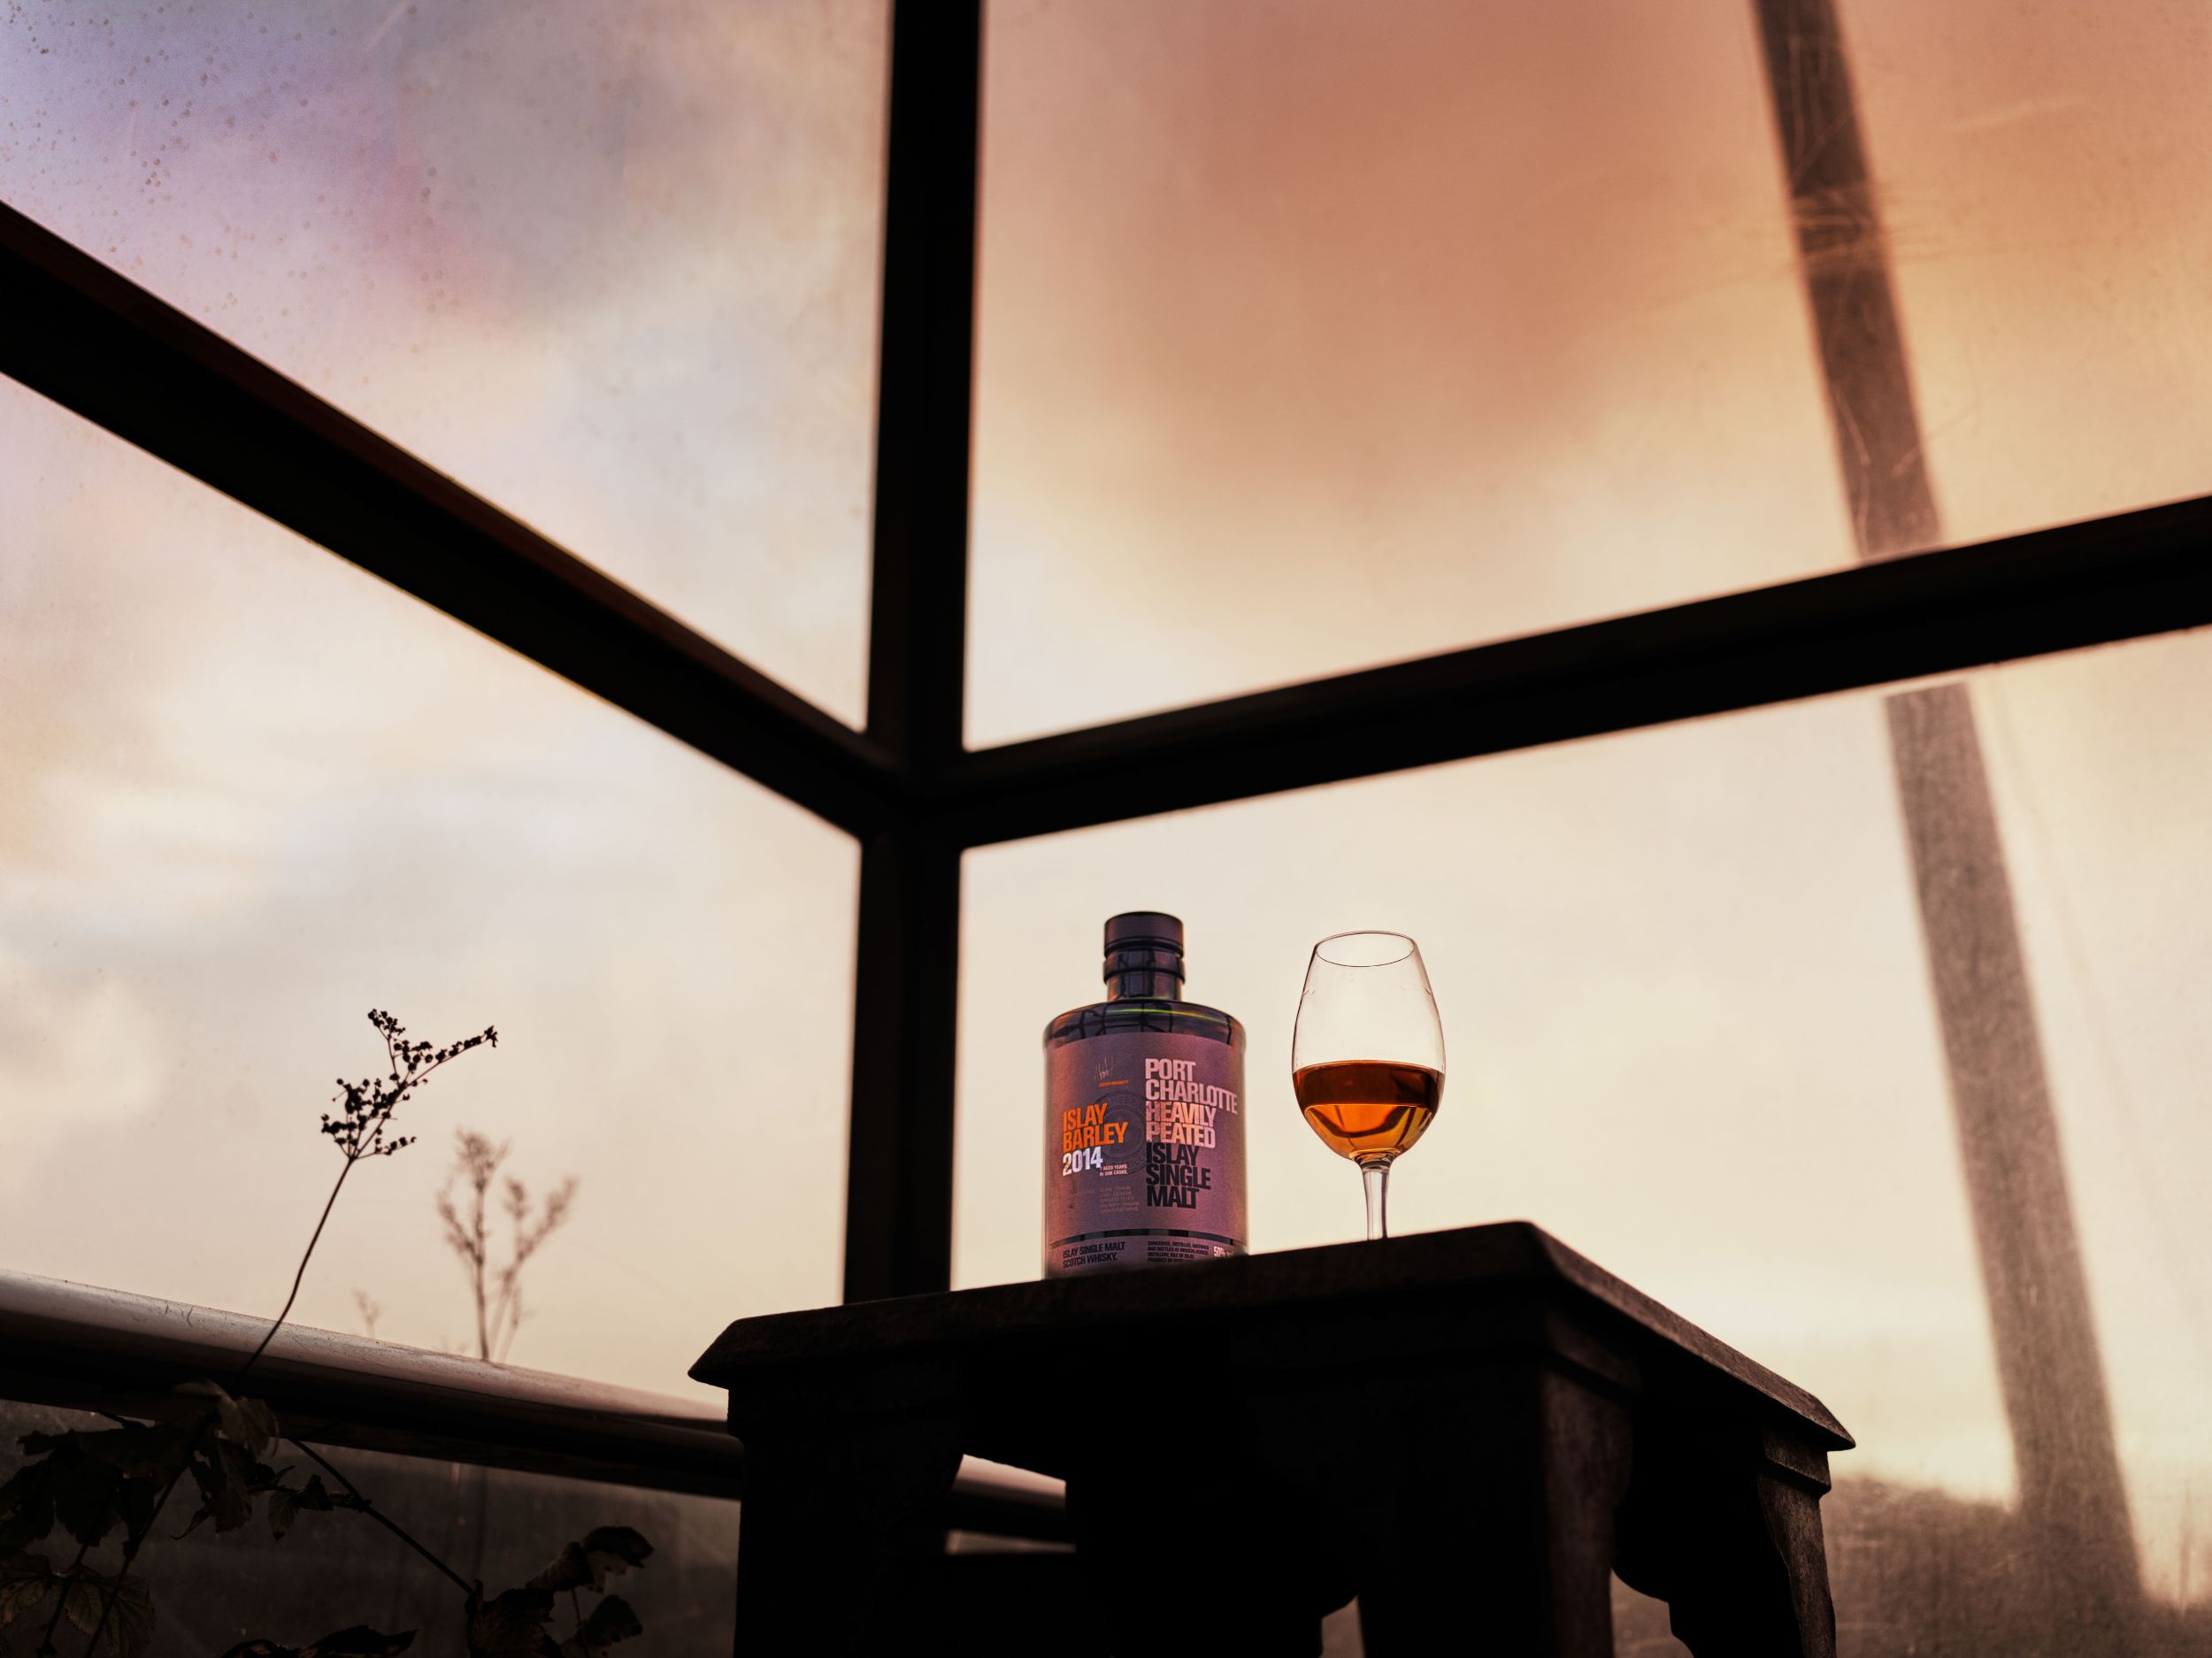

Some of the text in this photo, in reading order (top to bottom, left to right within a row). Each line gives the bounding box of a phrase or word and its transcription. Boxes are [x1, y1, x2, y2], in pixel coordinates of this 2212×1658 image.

[1145, 1058, 1196, 1081] PORT
[1145, 1079, 1237, 1115] CHARLOTTE
[1063, 1102, 1108, 1132] ISLAY
[1146, 1101, 1217, 1127] HEAVILY
[1063, 1121, 1128, 1153] BARLEY
[1146, 1122, 1216, 1149] PEATED
[1062, 1146, 1103, 1177] 2014
[1147, 1142, 1199, 1166] ISLAY
[1147, 1164, 1211, 1190] SINGLE
[1147, 1186, 1199, 1209] MALT
[1063, 1241, 1125, 1257] ISLAY SINGLE MALT
[1063, 1252, 1118, 1269] SCOTCH WHISKY.
